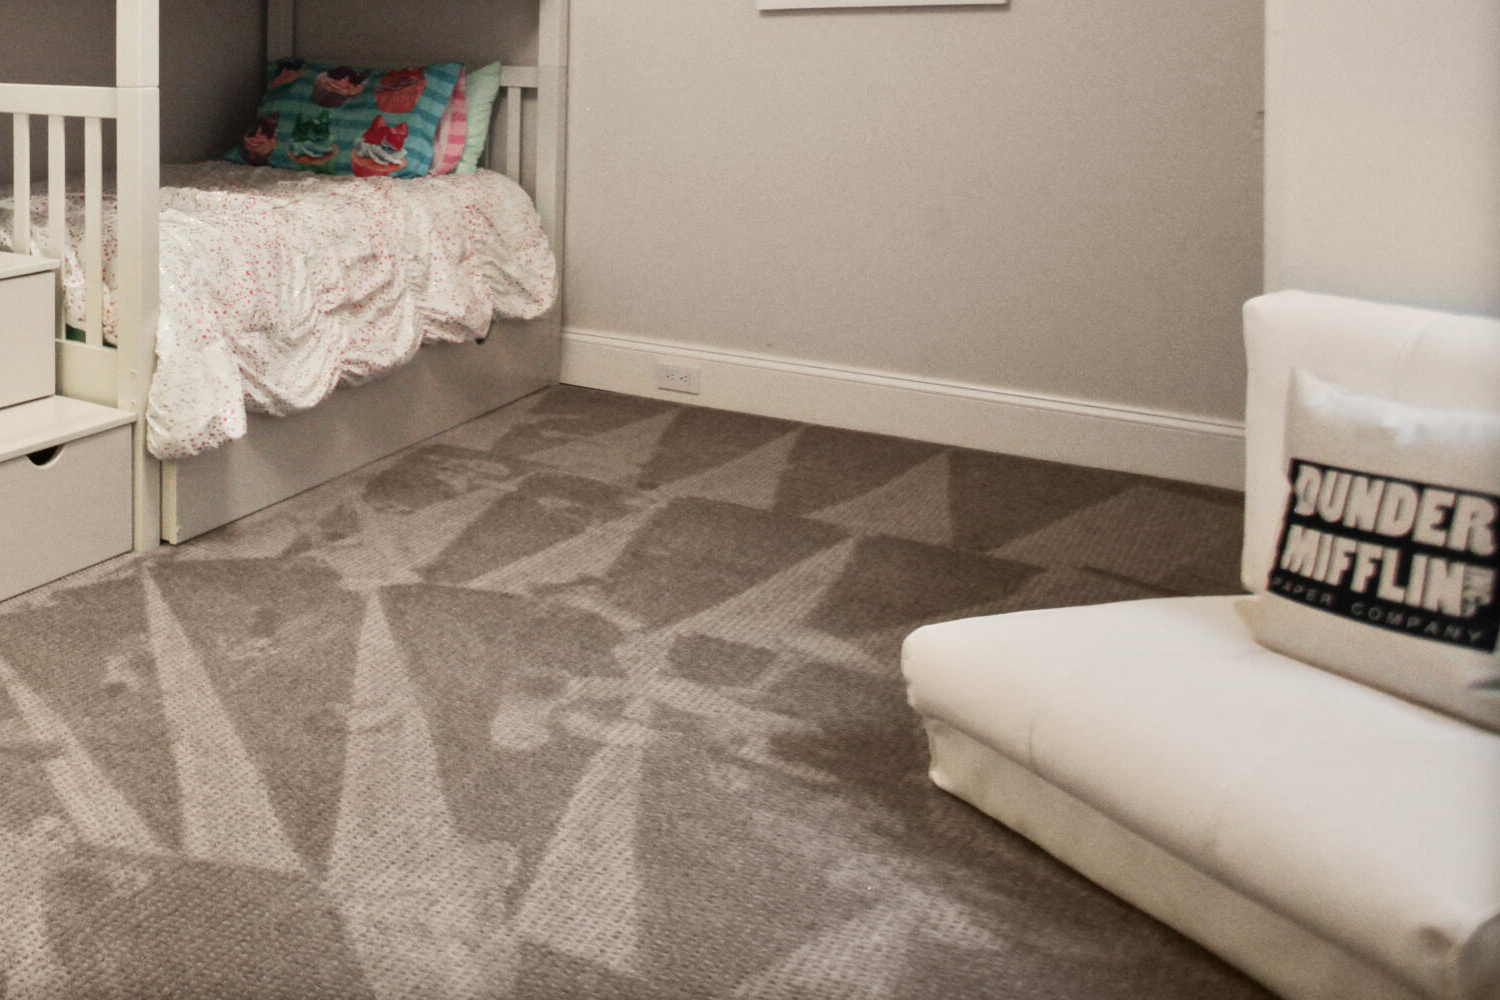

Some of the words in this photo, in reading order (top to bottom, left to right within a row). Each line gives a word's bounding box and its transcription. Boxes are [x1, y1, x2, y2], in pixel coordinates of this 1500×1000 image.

[1294, 465, 1496, 556] DUNDER
[1273, 577, 1332, 606] PAPER
[1351, 602, 1483, 643] COMPANY
[1280, 525, 1465, 617] MIFFLIN
